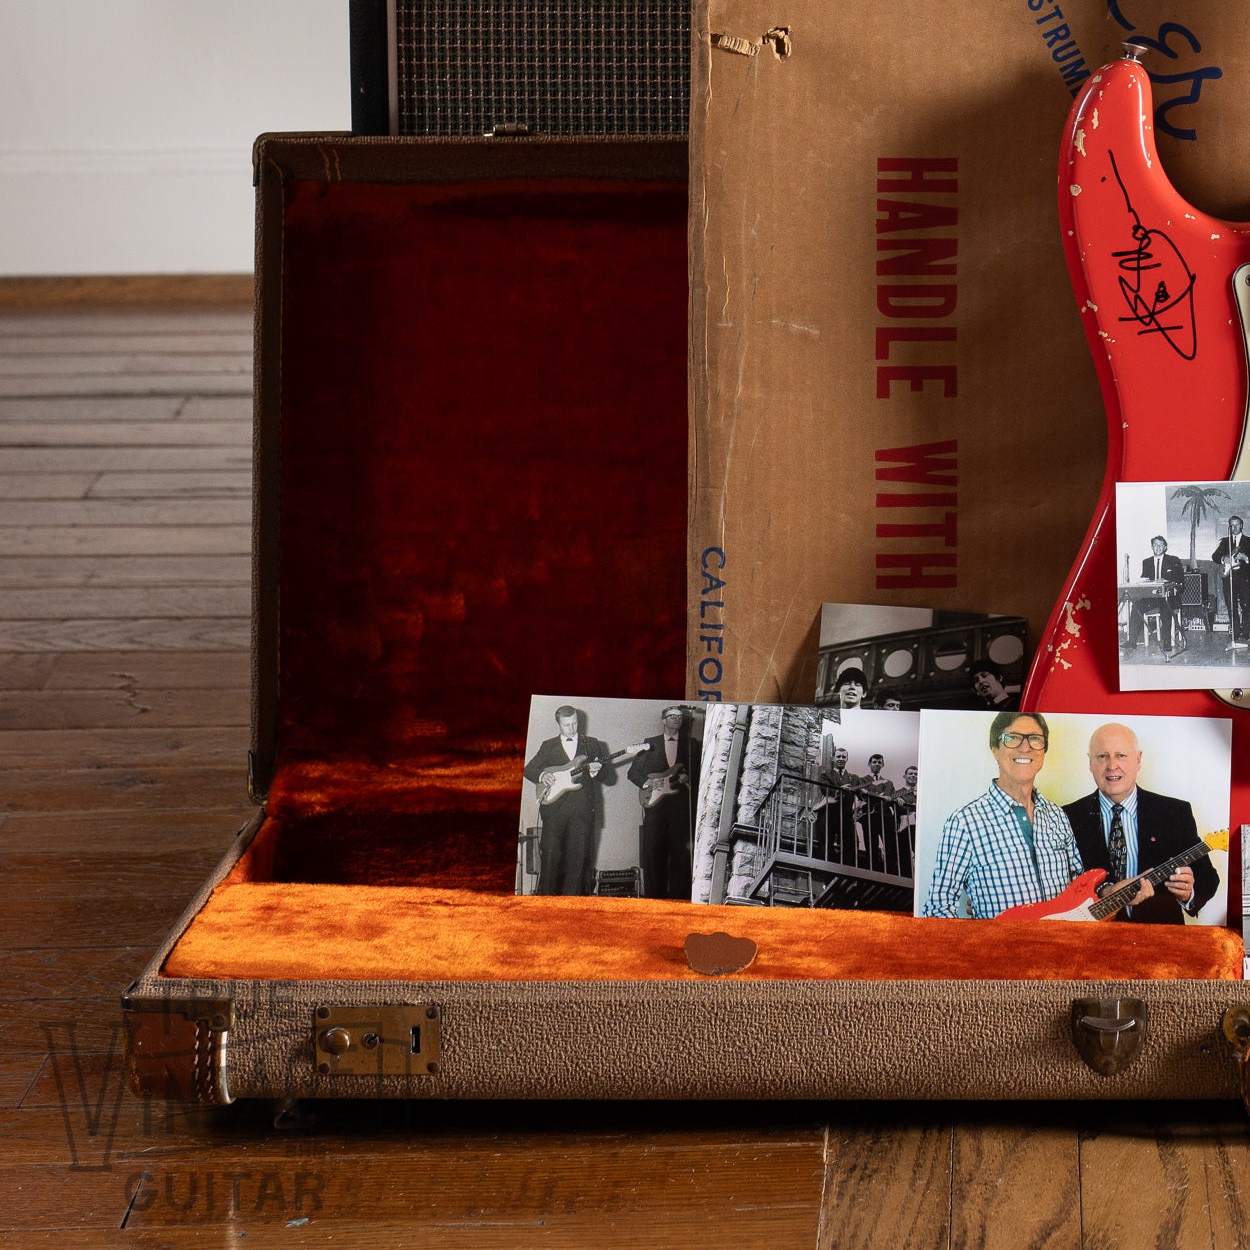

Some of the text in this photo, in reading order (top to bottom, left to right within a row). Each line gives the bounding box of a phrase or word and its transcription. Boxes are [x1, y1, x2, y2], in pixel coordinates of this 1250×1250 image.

[875, 157, 958, 590] HANDLE WITH
[698, 546, 728, 702] CALIFOR
